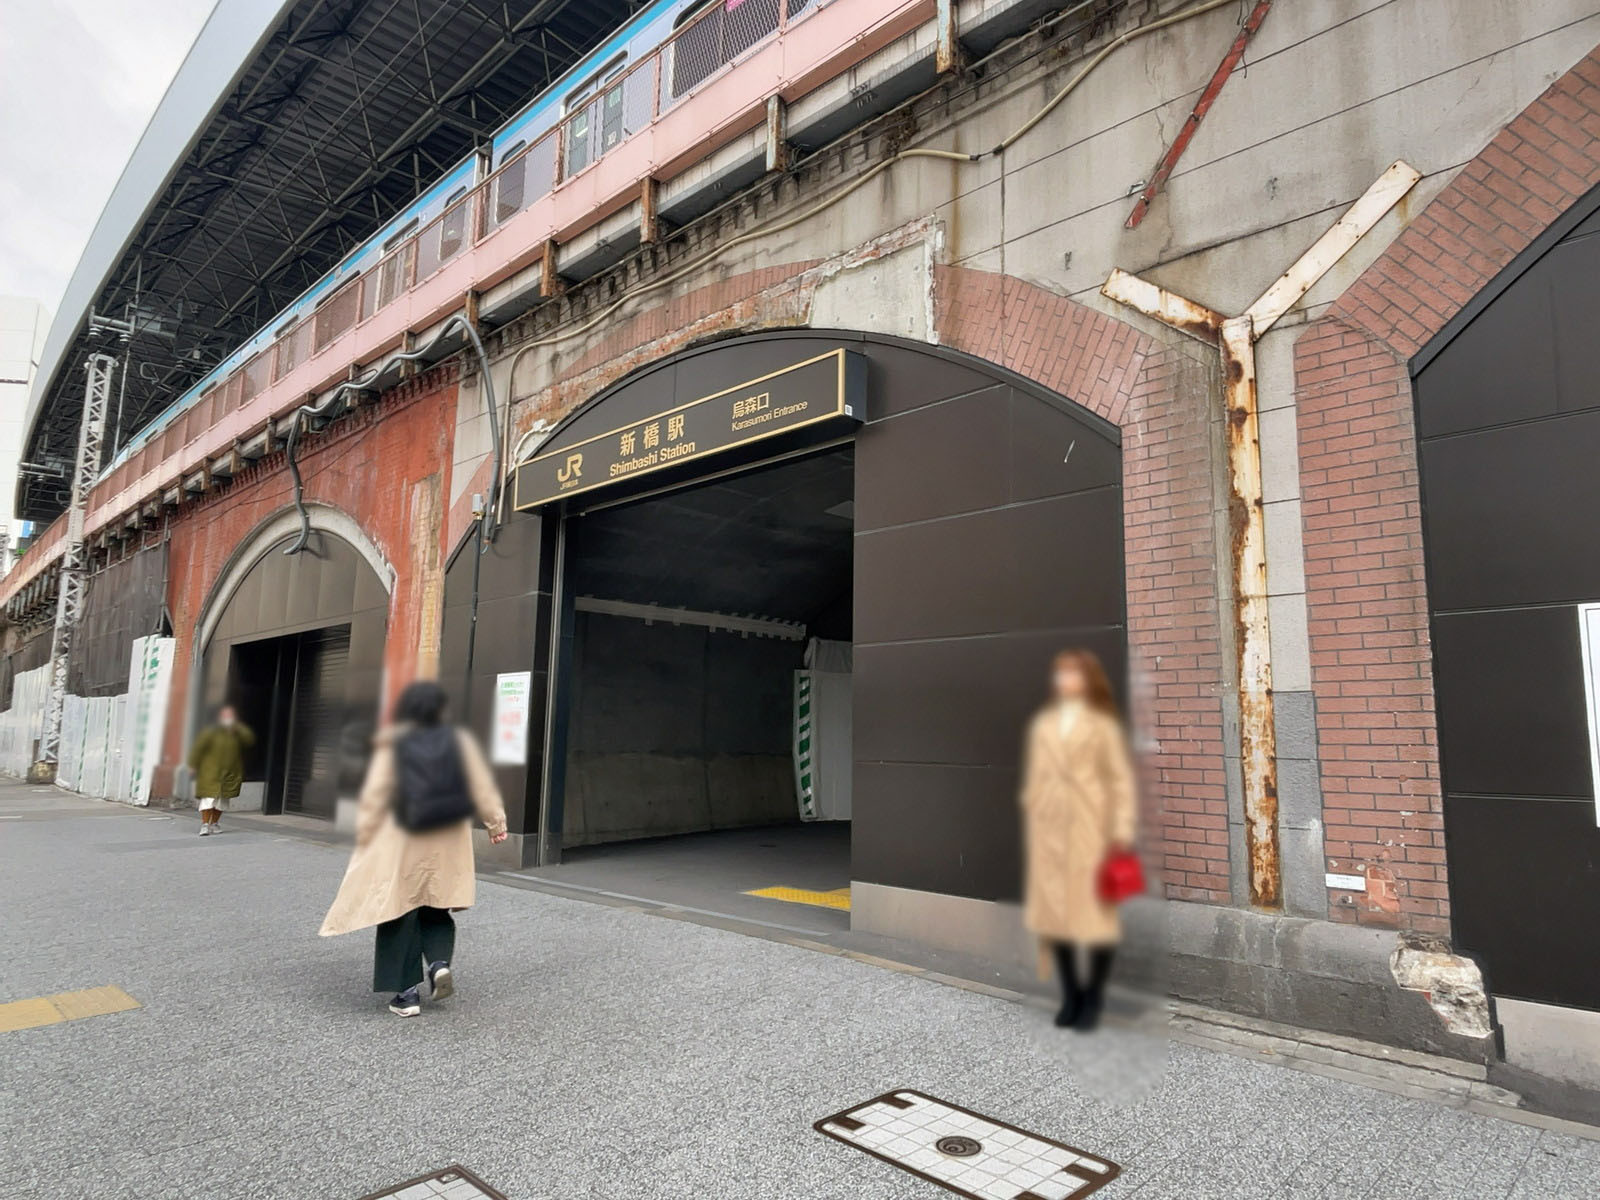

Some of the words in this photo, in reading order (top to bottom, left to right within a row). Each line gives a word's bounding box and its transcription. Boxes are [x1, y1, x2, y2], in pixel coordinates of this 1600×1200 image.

[731, 410, 772, 431] Karasumori
[773, 401, 808, 419] Entrance
[620, 414, 684, 456] 新橋駅
[557, 453, 583, 482] JR
[609, 450, 658, 477] Shimbashi
[660, 441, 696, 461] Station
